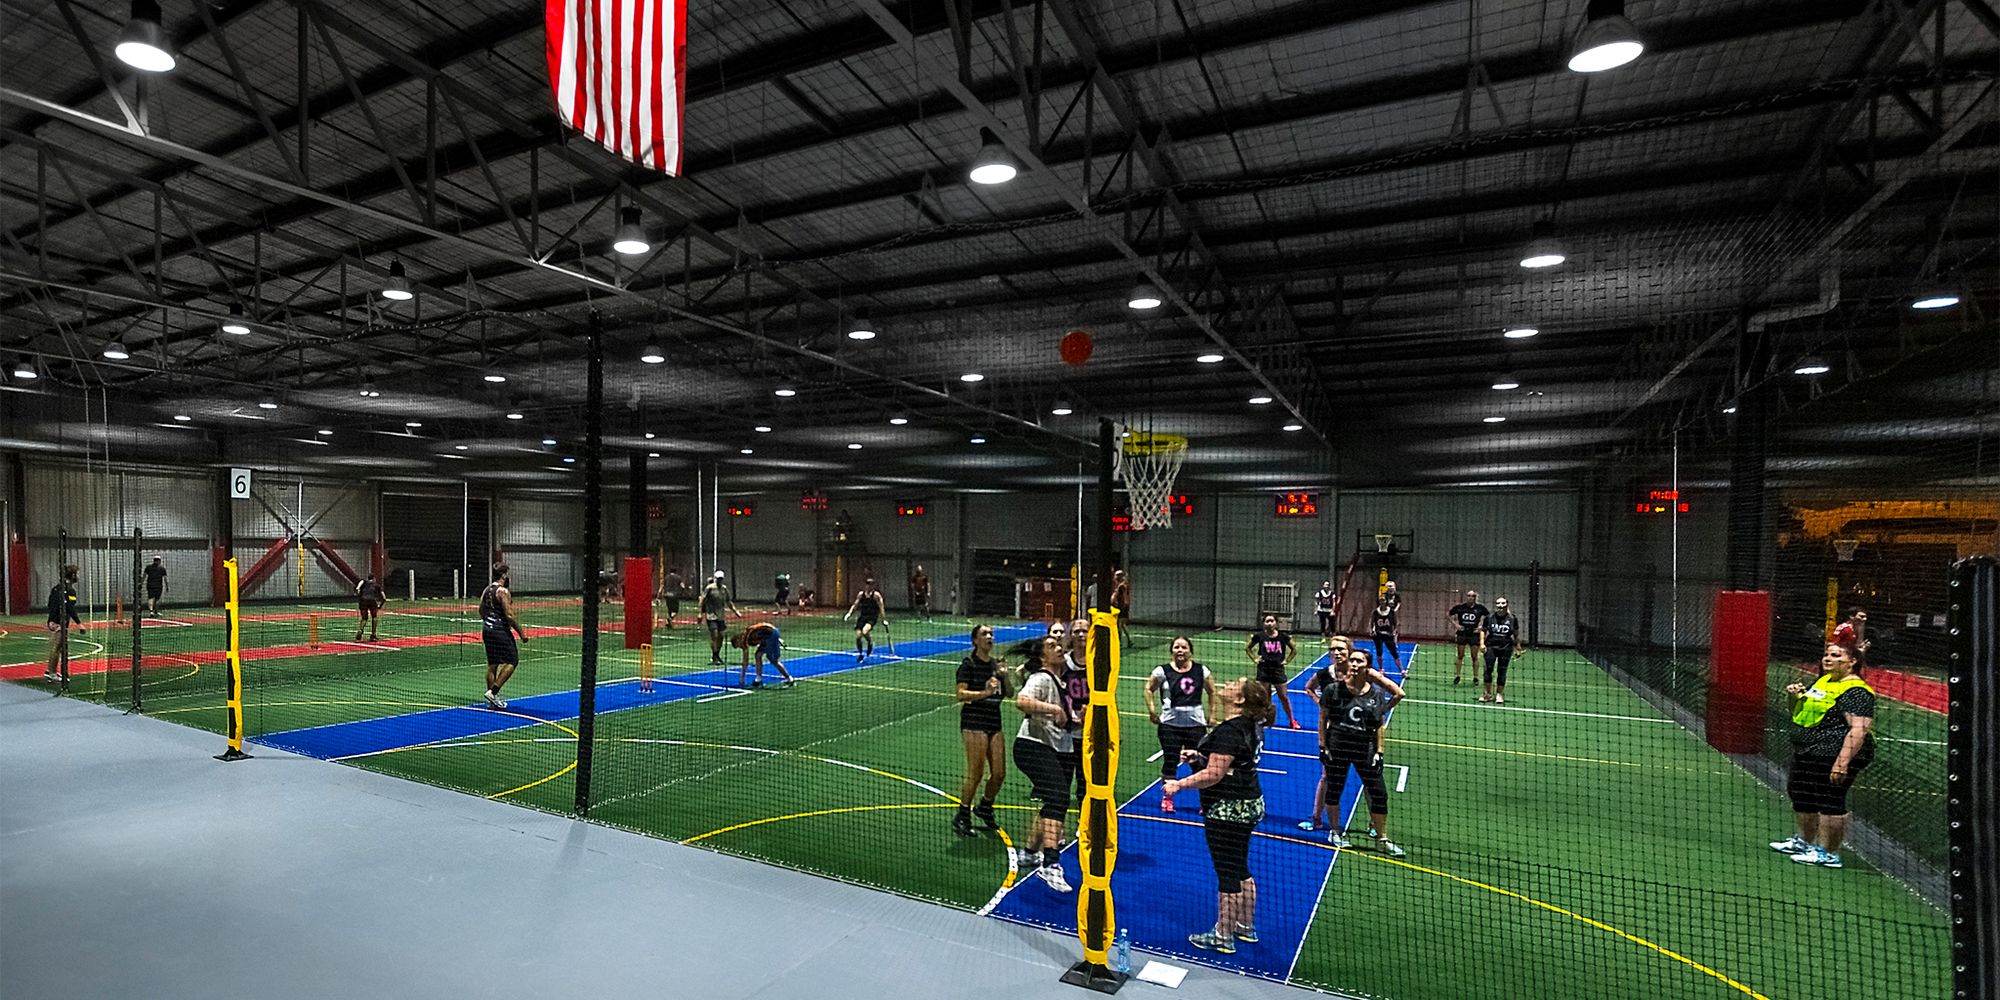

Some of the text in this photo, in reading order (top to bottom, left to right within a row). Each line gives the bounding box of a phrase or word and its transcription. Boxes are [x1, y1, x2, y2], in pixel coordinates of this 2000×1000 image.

[235, 474, 247, 494] 6
[1461, 613, 1476, 621] GD
[1264, 641, 1283, 654] WA
[1180, 676, 1195, 695] C
[1349, 706, 1364, 722] C
